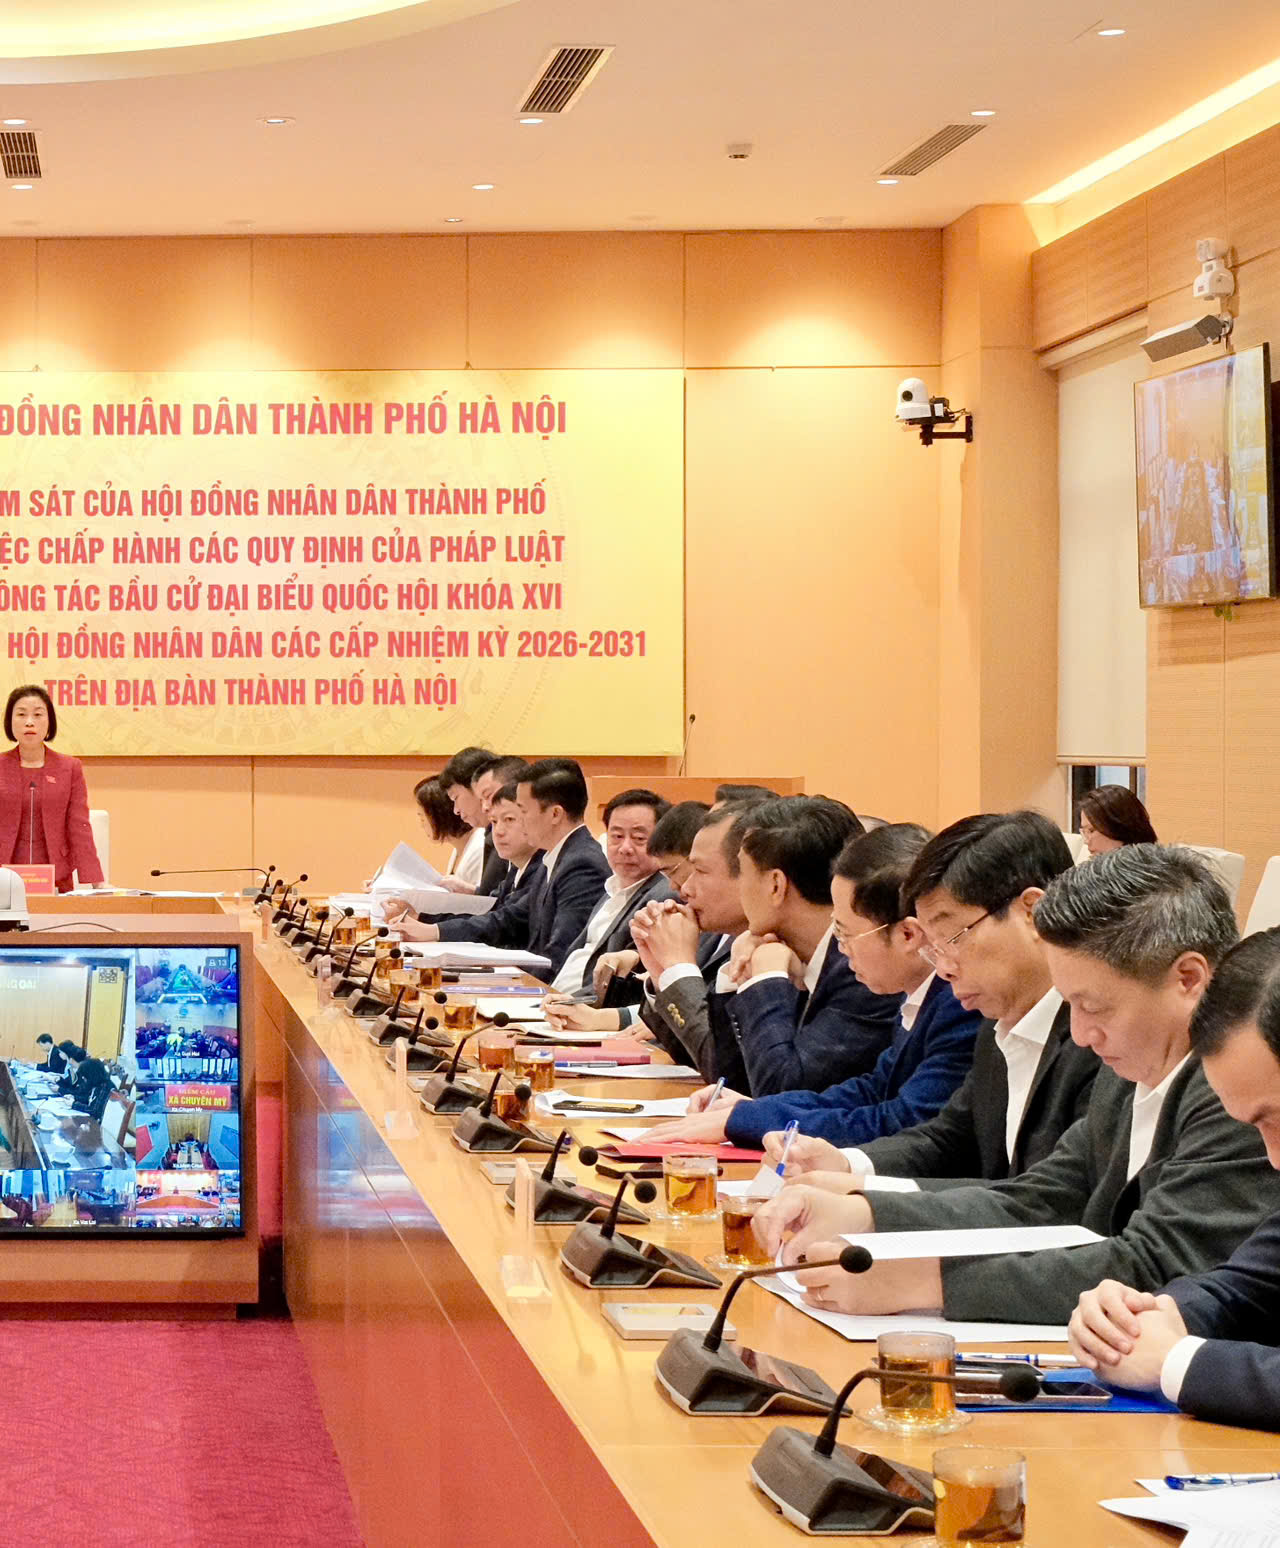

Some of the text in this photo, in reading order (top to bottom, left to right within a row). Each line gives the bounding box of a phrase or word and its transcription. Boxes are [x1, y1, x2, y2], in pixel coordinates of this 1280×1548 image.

[95, 398, 181, 435] NHÂN
[195, 398, 256, 434] DÂN
[270, 396, 373, 434] THÀNH
[385, 391, 447, 434] PHỐ
[461, 396, 500, 433] HÀ
[512, 395, 565, 440] NỘI
[31, 483, 75, 516] SÁT
[85, 482, 133, 516] CỦA
[142, 484, 182, 522] HỘI
[192, 480, 258, 516] ĐỒNG
[269, 484, 336, 515] NHÂN
[347, 484, 396, 515] DÂN
[406, 483, 487, 515] THÀNH
[496, 478, 546, 514] PHỐ
[39, 528, 104, 564] CHẤP
[114, 533, 180, 564] HÀNH
[190, 532, 238, 563] CÁC
[248, 536, 294, 566] QUY
[304, 536, 363, 568] ĐỊNH
[373, 528, 422, 563] CỦA
[431, 531, 496, 562] PHÁP
[506, 530, 564, 568] LUẬT
[54, 580, 100, 611] TÁC
[110, 576, 158, 611] BẦU
[168, 576, 202, 611] CỬ
[208, 584, 248, 616] ĐẠI
[258, 573, 314, 610] BIỂU
[323, 575, 388, 613] QUỐC
[398, 578, 438, 616] HỘI
[448, 578, 513, 610] KHÓA
[523, 584, 562, 610] XVI
[8, 626, 48, 664] HỘI
[57, 624, 125, 659] ĐỒNG
[134, 626, 203, 658] NHÂN
[212, 626, 262, 658] DÂN
[272, 626, 320, 658] CÁC
[330, 621, 379, 658] CẤP
[388, 626, 469, 664] NHIỆM
[479, 625, 509, 657] KỲ
[518, 631, 645, 657] 2026-2031
[44, 670, 456, 712] TRÊN ĐỊA BÀN THÀNH PHỐ HÀ NỘI
[218, 959, 227, 967] 13
[181, 1095, 212, 1106] CHUYÊN
